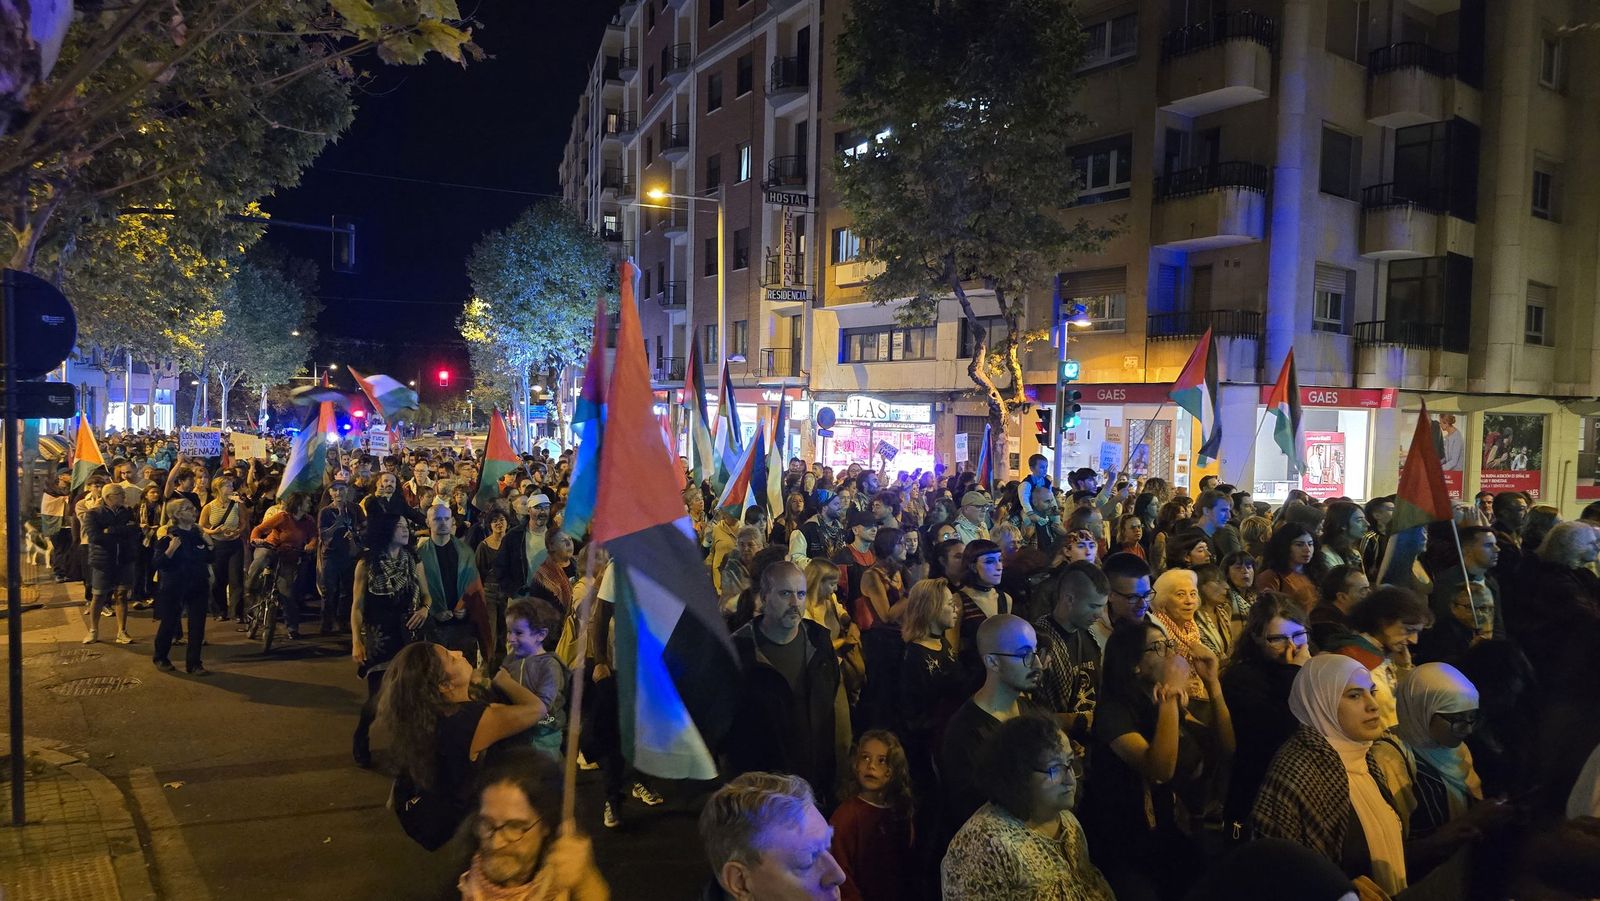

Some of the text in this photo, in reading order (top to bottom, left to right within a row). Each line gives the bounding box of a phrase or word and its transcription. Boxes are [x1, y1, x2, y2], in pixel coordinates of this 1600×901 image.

[769, 192, 805, 204] HOSTAL
[784, 206, 792, 288] INTERNACIONAL
[767, 290, 806, 300] RESIDENCIA
[1097, 389, 1126, 400] GAES
[1308, 391, 1338, 404] GAES
[183, 447, 219, 455] AMENAZA
